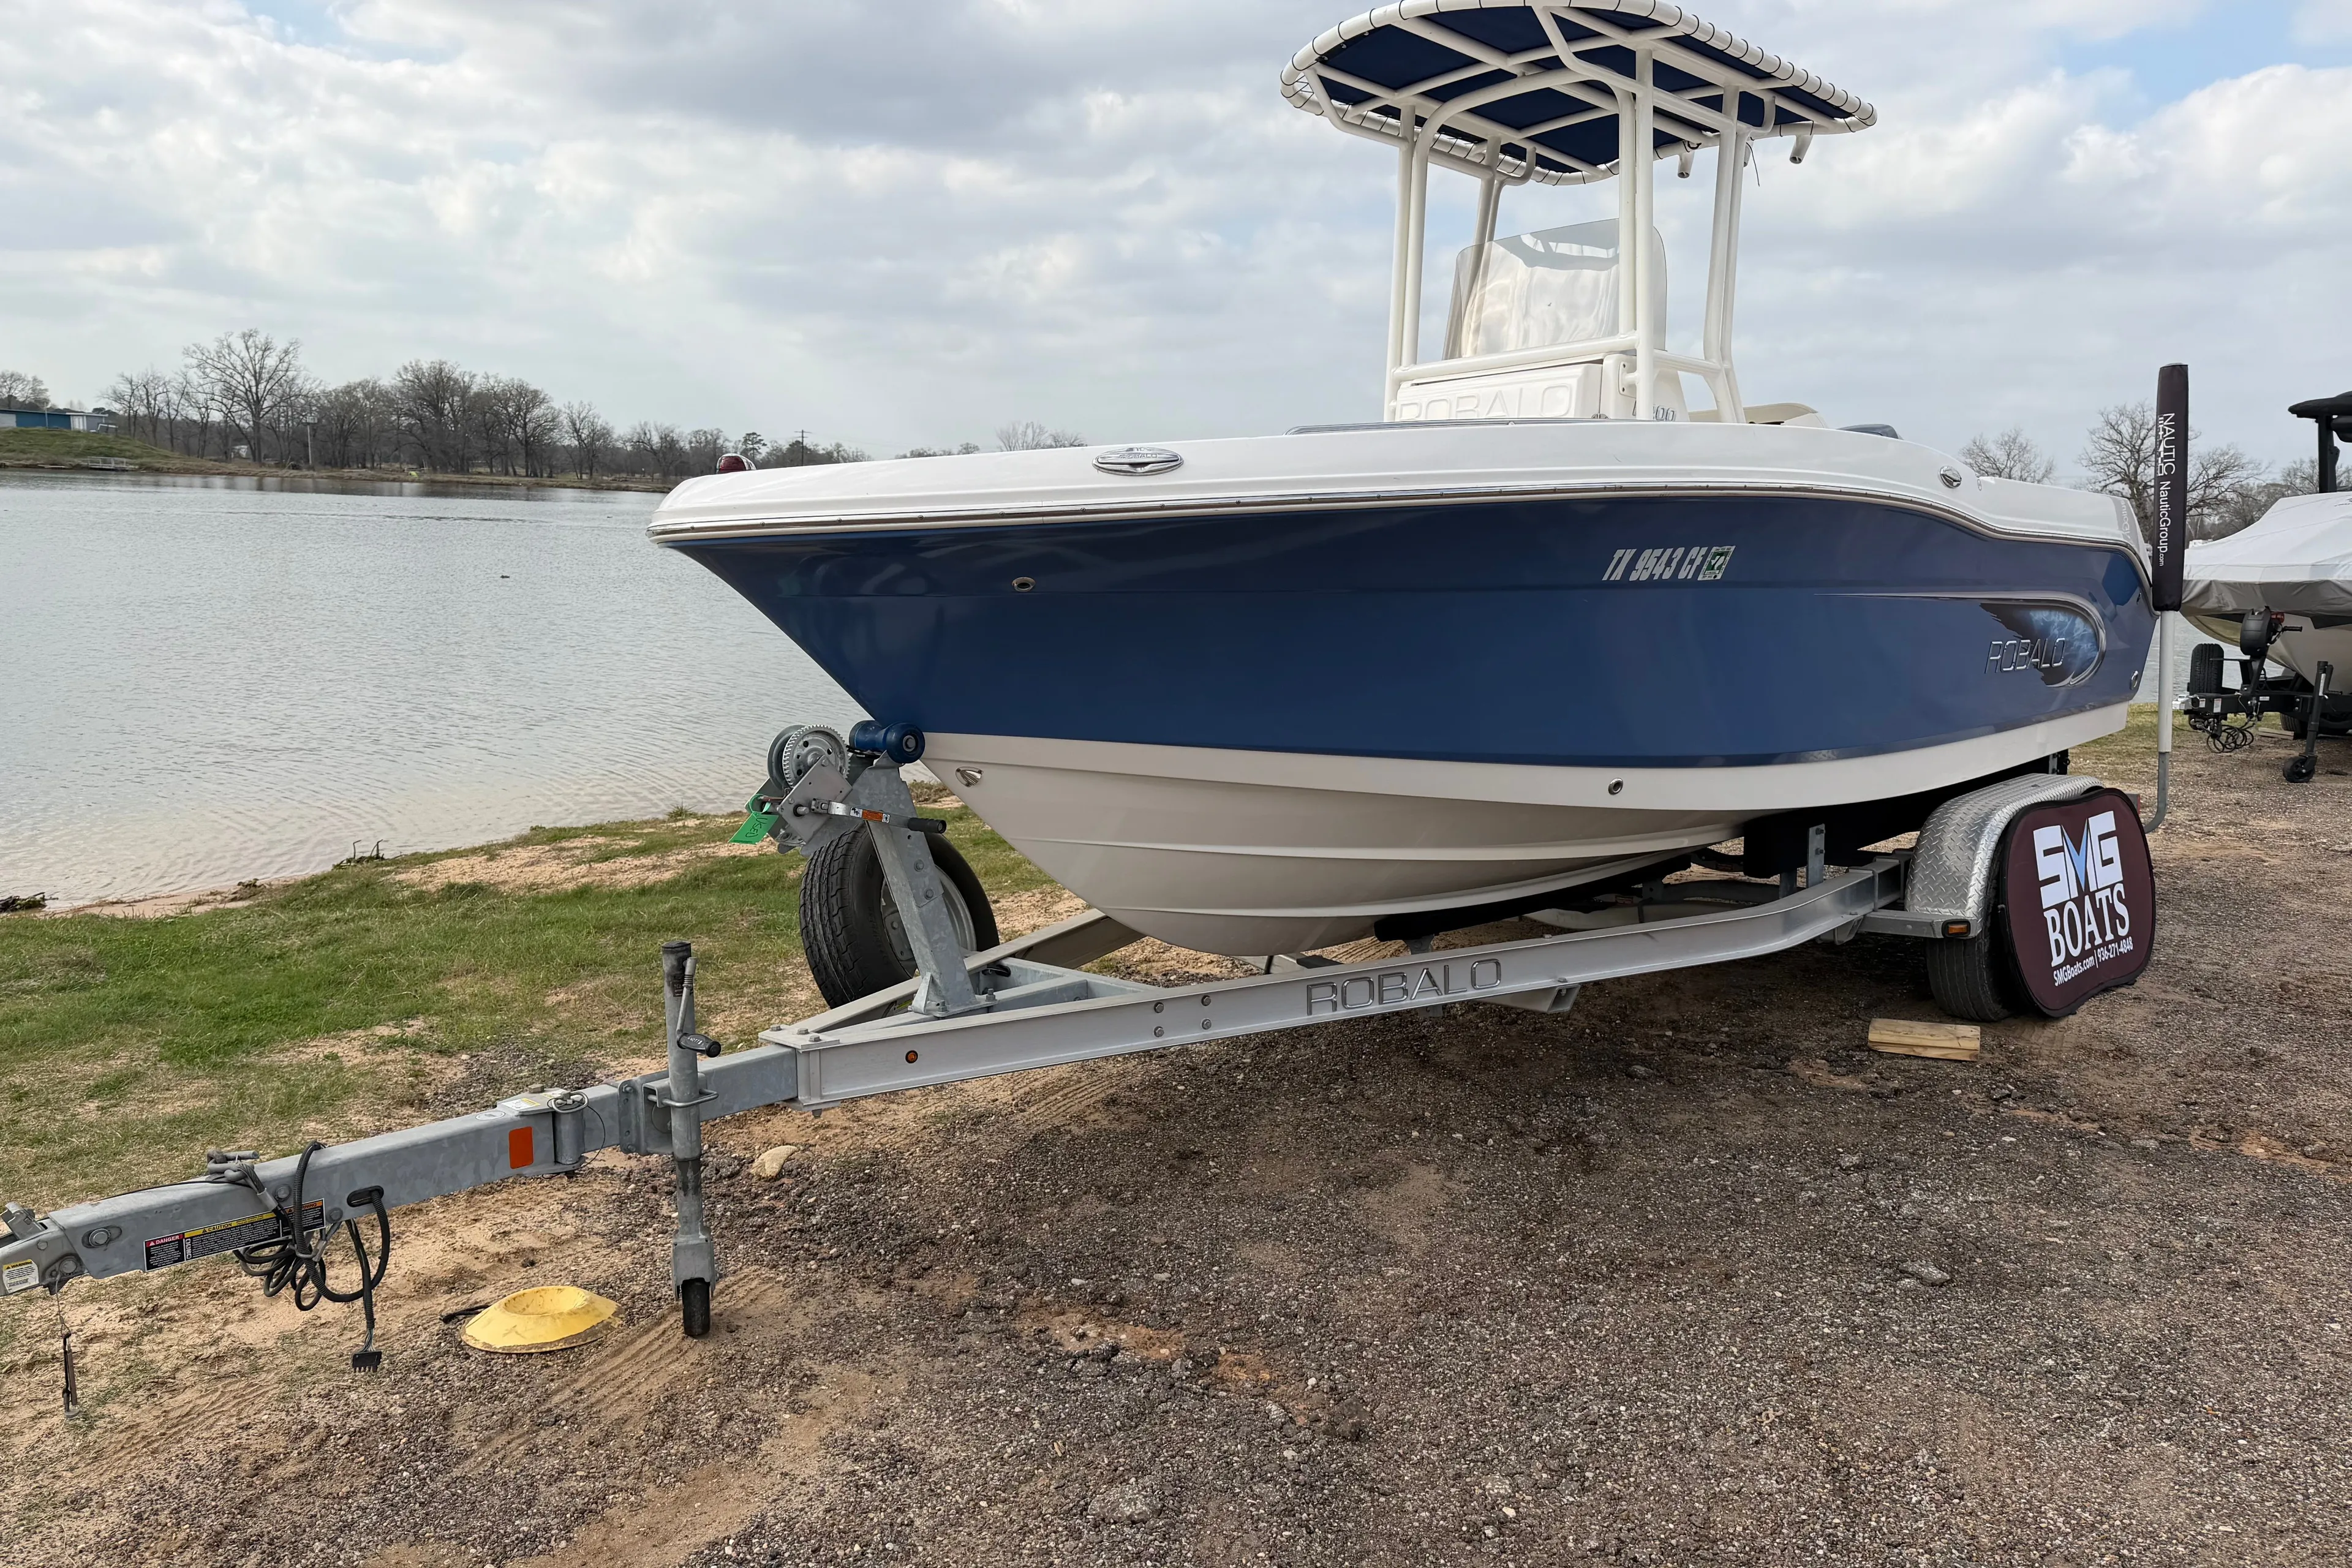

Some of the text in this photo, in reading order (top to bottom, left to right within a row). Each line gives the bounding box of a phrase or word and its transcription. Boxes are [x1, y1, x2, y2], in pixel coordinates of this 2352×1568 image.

[2163, 413, 2176, 475] NAUTIC
[2157, 481, 2171, 566] NauticGroup.com
[1602, 548, 1637, 581] TX
[1629, 546, 1685, 581] 9543
[1678, 546, 1708, 579] CF
[1985, 638, 2066, 673] ROBALO
[745, 817, 768, 838] USED
[2033, 810, 2124, 909] SMG
[2043, 883, 2130, 968] BOATS
[1306, 958, 1502, 1016] ROBALO
[2053, 956, 2095, 987] SMGBoats.com
[2097, 936, 2133, 962] 936-271-4848
[155, 1235, 179, 1245] DANGER
[208, 1223, 233, 1232] CAUTION
